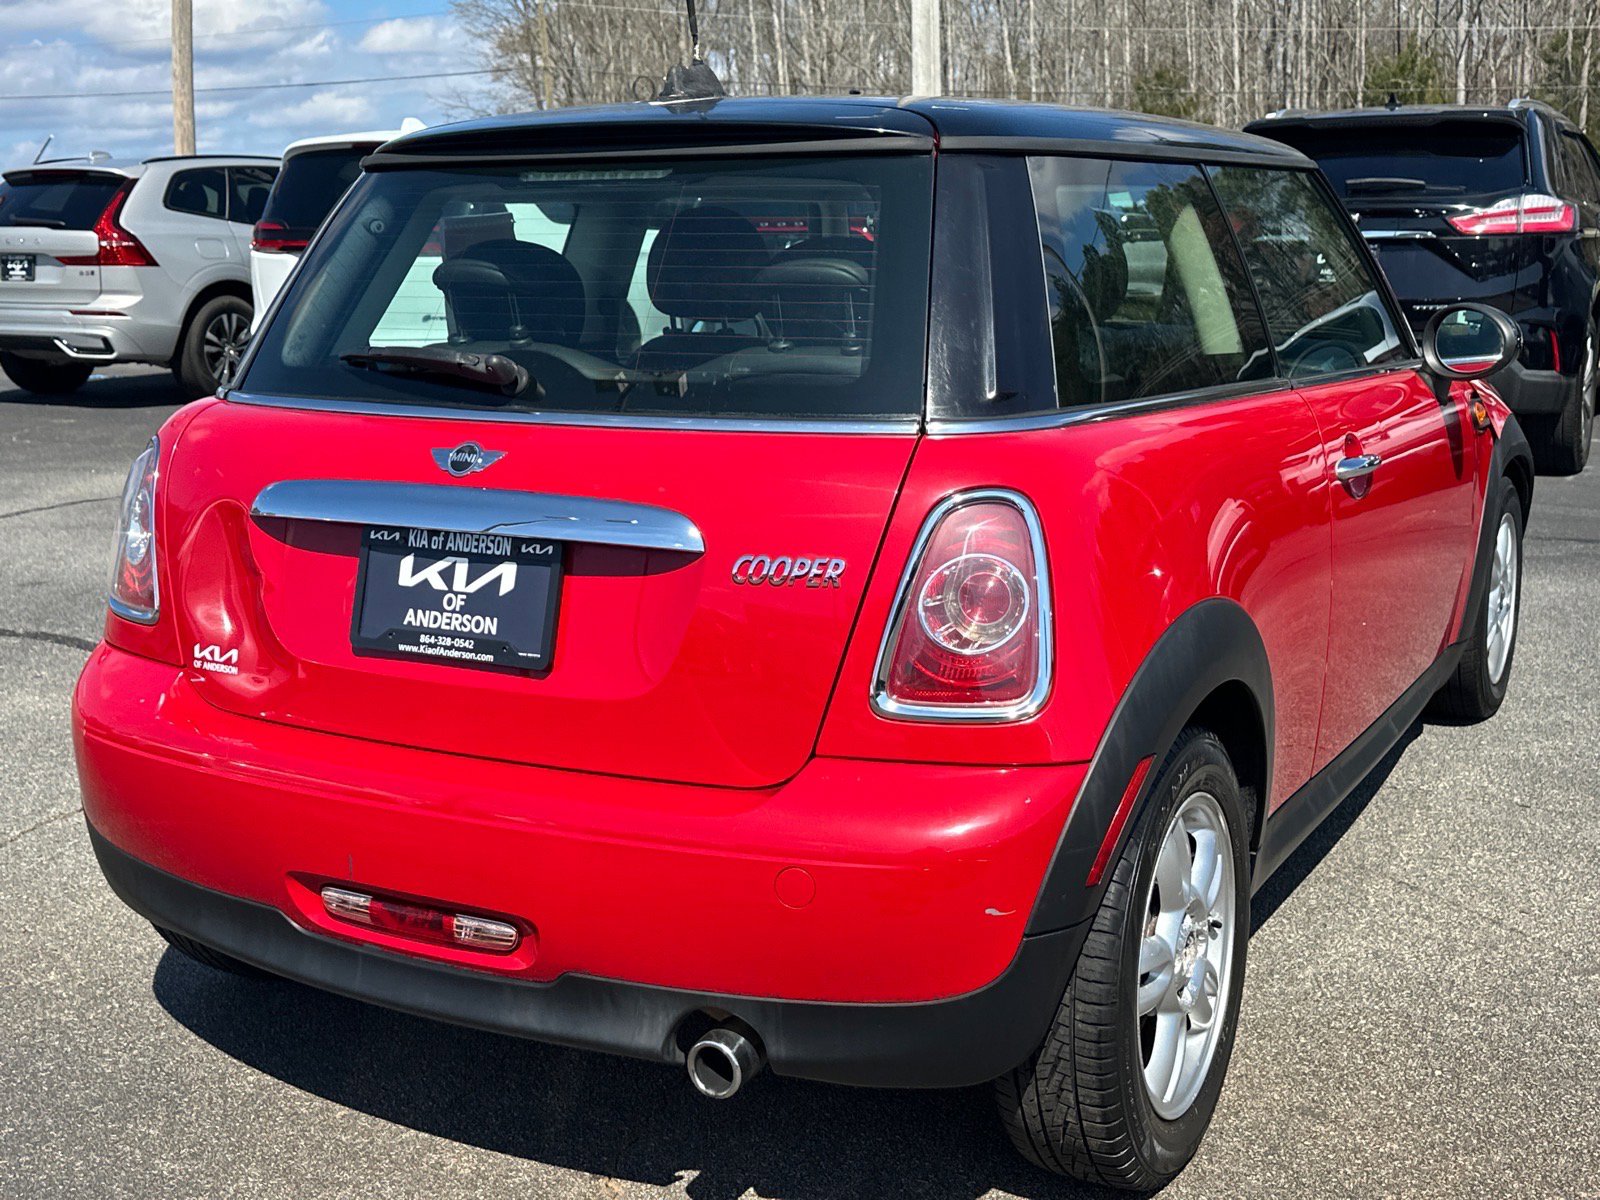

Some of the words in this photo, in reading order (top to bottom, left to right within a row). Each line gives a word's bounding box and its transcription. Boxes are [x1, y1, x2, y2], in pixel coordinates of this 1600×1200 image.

[451, 452, 477, 463] MINI
[408, 528, 428, 549] KIA
[431, 531, 445, 550] of
[445, 532, 513, 556] ANDERSON
[398, 552, 518, 597] KIA
[731, 554, 846, 588] COOPER
[442, 593, 467, 612] OF
[403, 608, 498, 635] ANDERSON
[419, 633, 475, 649] 864-328-0542
[398, 643, 494, 662] www.KiaofAnderson.com
[193, 659, 203, 669] OF
[202, 661, 239, 675] ANDERSON
